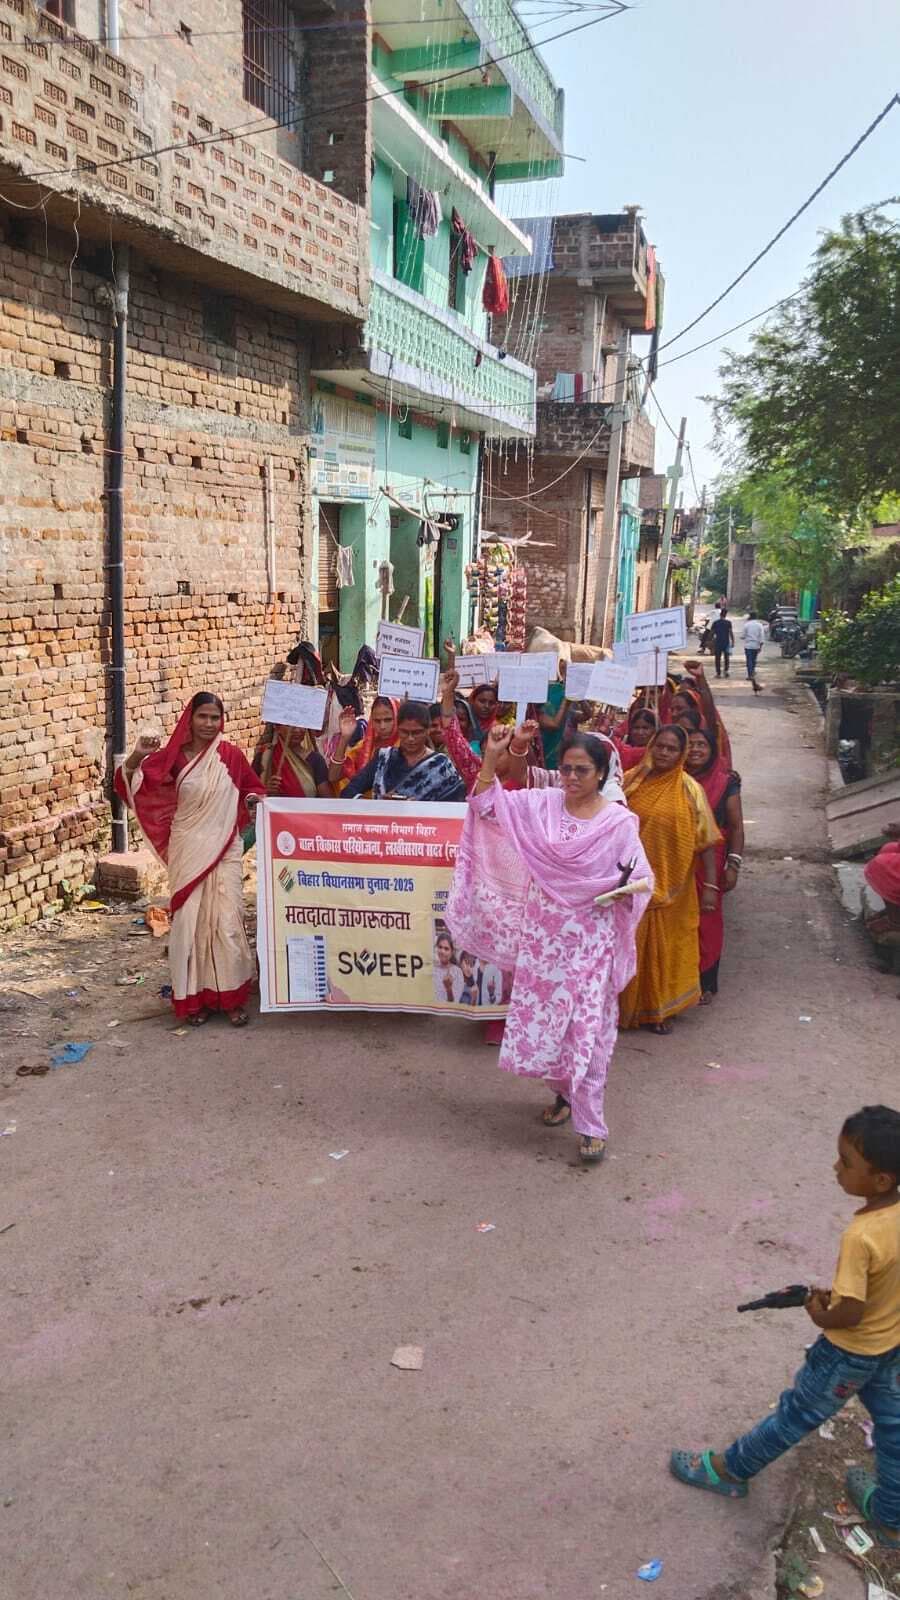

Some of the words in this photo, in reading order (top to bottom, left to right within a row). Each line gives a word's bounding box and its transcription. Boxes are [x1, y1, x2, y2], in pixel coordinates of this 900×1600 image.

[416, 822, 437, 837] बिहार
[316, 835, 341, 853] विकास
[297, 870, 320, 887] बिहार
[321, 871, 365, 889] विधानसभा
[367, 876, 414, 895] चुनाव-2025
[285, 905, 336, 928] मतदाता
[338, 908, 411, 931] जागरूकता
[338, 949, 424, 979] SWEEP
